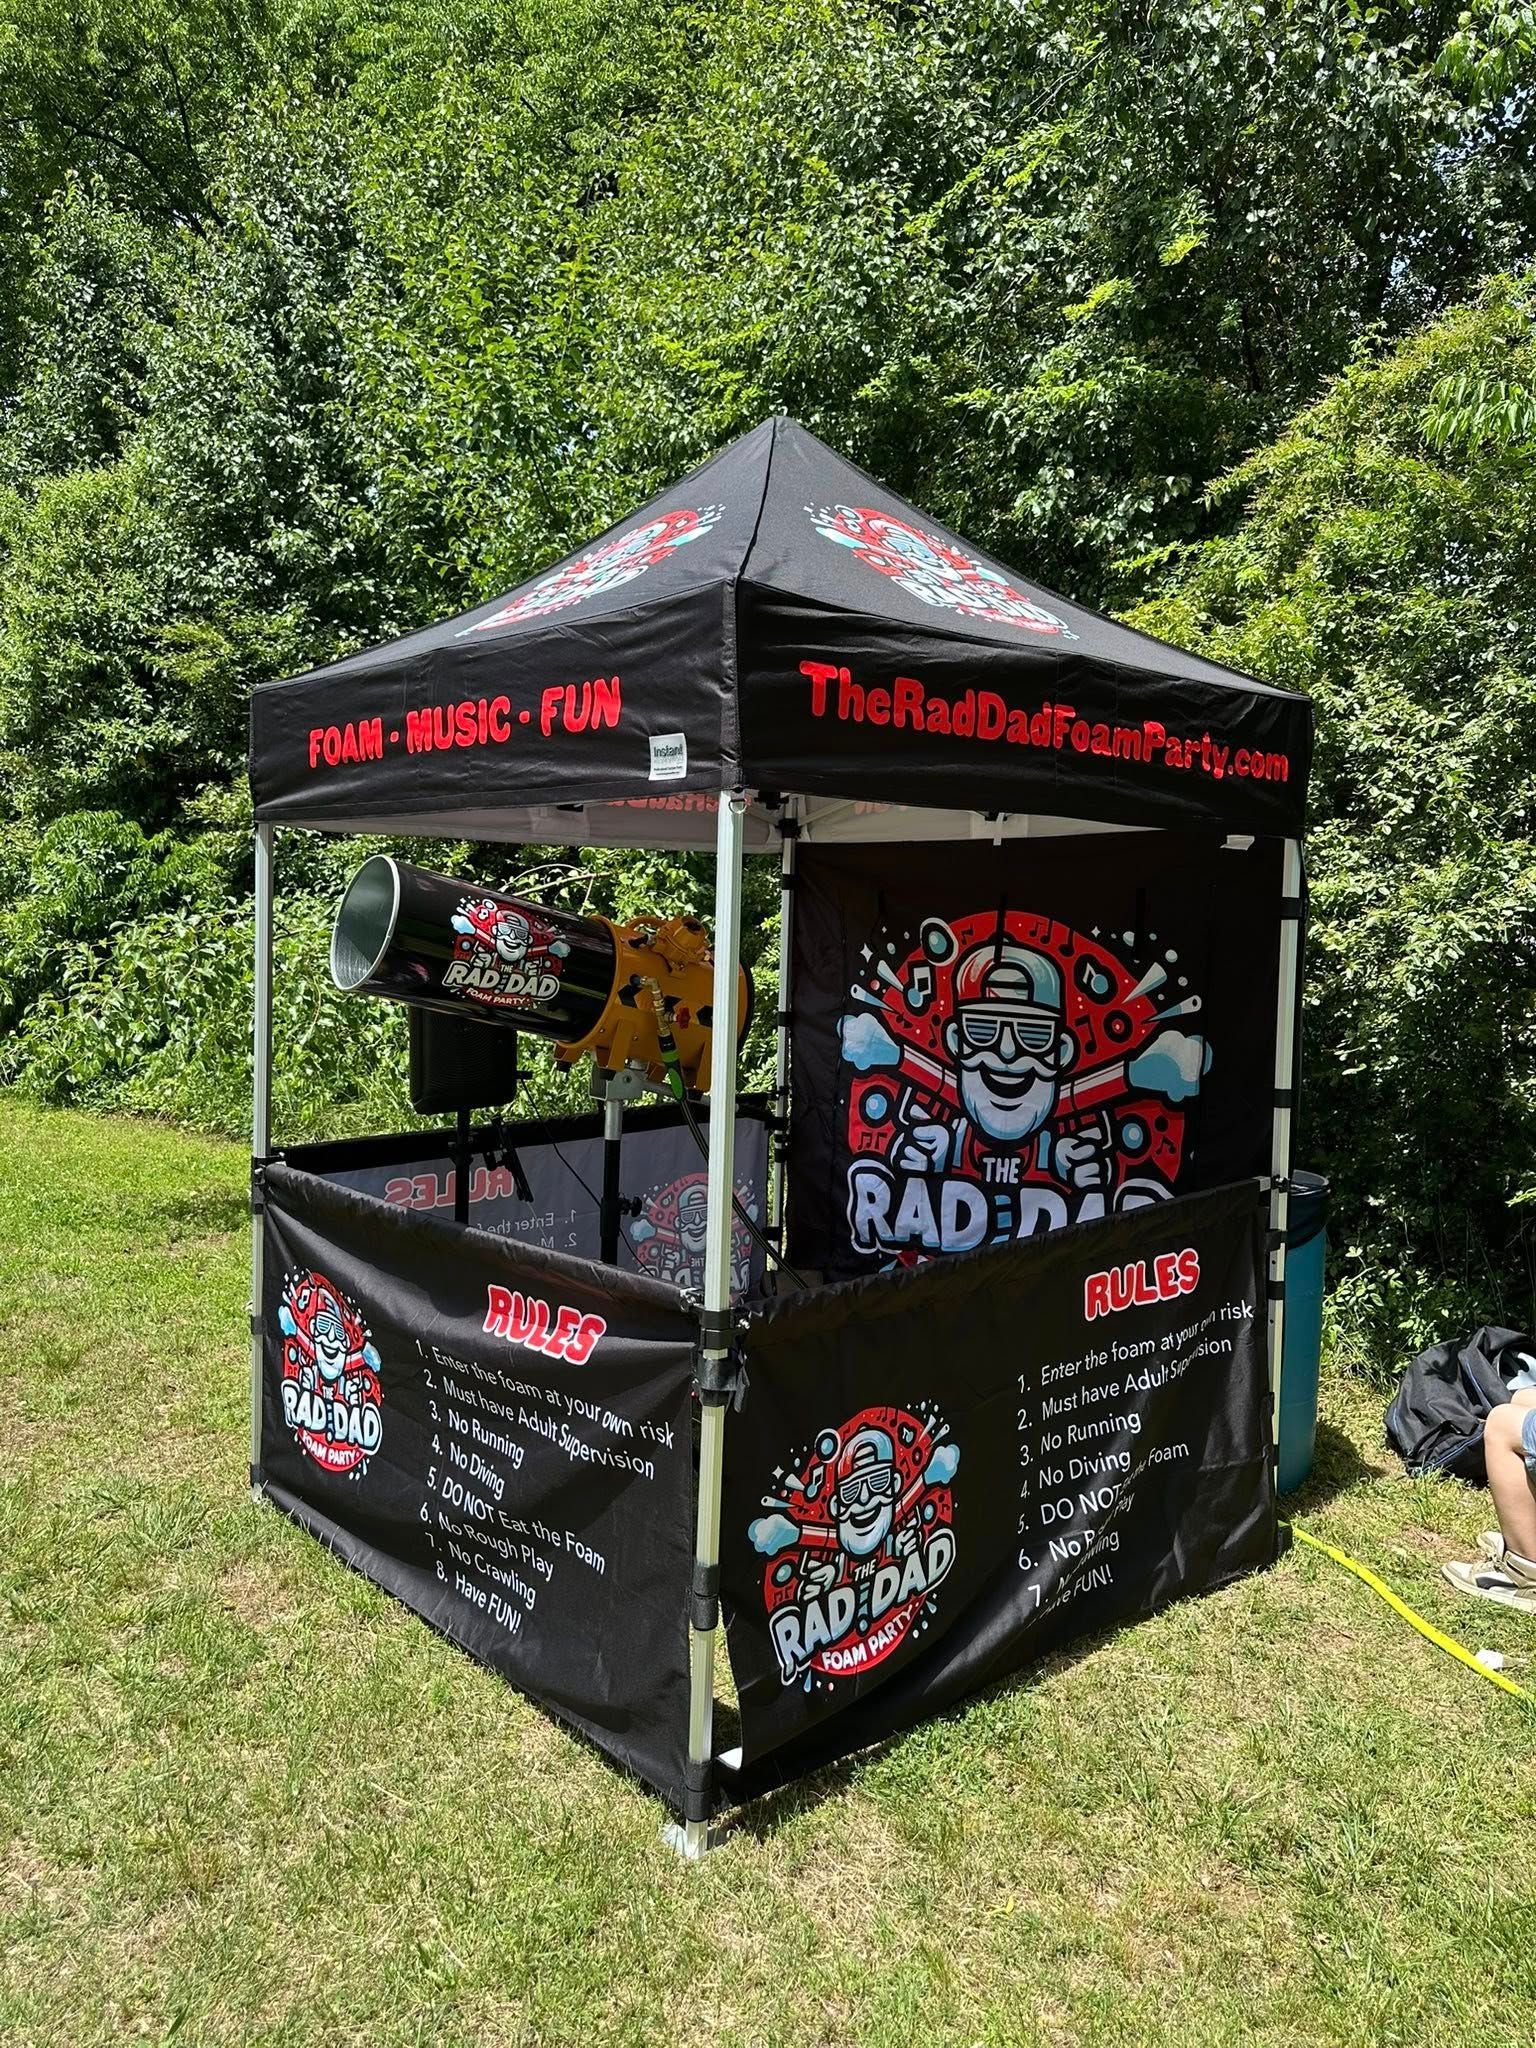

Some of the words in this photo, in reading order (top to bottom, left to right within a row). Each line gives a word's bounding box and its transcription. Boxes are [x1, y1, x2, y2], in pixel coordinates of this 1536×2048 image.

[309, 717, 384, 769] FOAM
[406, 695, 511, 754] MUSIC
[540, 675, 623, 737] FUN
[800, 660, 1289, 783] TheRadDadFoamParty.com
[445, 964, 501, 989] RAD
[503, 973, 557, 998] DAD
[465, 987, 493, 1002] FOAM
[493, 996, 527, 1006] PARTY
[501, 964, 514, 974] THE
[982, 1156, 1021, 1185] THE
[855, 1173, 988, 1253] RAD
[1085, 1248, 1200, 1322] RULES
[482, 1284, 607, 1366] RULES
[1017, 1374, 1031, 1394] 1.
[1041, 1359, 1082, 1387] Enter
[1084, 1350, 1108, 1371] the
[1110, 1339, 1155, 1362] foam
[1160, 1332, 1174, 1350] at
[1175, 1323, 1199, 1351] your
[1220, 1300, 1254, 1320] risk
[283, 1386, 327, 1431] RAD
[333, 1401, 380, 1447] DAD
[415, 1338, 429, 1359] 1.
[431, 1346, 470, 1375] Enter
[472, 1362, 497, 1385] the
[497, 1370, 543, 1400] foam
[545, 1387, 562, 1407] at
[564, 1394, 602, 1422] your
[601, 1411, 634, 1438] own
[640, 1421, 675, 1449] risk
[1017, 1409, 1033, 1431] 2.
[1041, 1393, 1078, 1420] Must
[1081, 1380, 1120, 1406] have
[1124, 1364, 1169, 1394] Adult
[1170, 1337, 1232, 1379] Spsion
[302, 1430, 328, 1460] FOAM
[328, 1449, 356, 1465] PARTY
[423, 1368, 437, 1389] 2.
[443, 1376, 478, 1407] Must
[480, 1393, 514, 1421] have
[518, 1407, 558, 1442] Adult
[558, 1424, 655, 1480] Supervision
[429, 1400, 442, 1422] 3.
[447, 1408, 469, 1435] No
[472, 1419, 525, 1470] Running
[1020, 1444, 1034, 1466] 3.
[1040, 1431, 1062, 1455] No
[1067, 1412, 1142, 1444] Running
[431, 1434, 443, 1456] 4.
[449, 1441, 468, 1469] No
[469, 1453, 505, 1501] Diving
[1017, 1513, 1029, 1534] 5.
[1040, 1498, 1074, 1525] DO
[1078, 1483, 1122, 1515] NOT
[1148, 1443, 1190, 1467] Foam
[1020, 1480, 1031, 1499] 4.
[1039, 1467, 1064, 1489] No
[1069, 1451, 1131, 1481] Diving
[420, 1502, 432, 1524] 6.
[438, 1511, 463, 1537] No
[464, 1524, 519, 1560] Rough
[521, 1544, 554, 1583] Play
[426, 1465, 438, 1491] 5.
[442, 1477, 463, 1506] DO
[463, 1498, 495, 1524] NOT
[498, 1510, 530, 1535] Eat
[532, 1521, 562, 1547] the
[565, 1531, 606, 1576] Foam
[1018, 1548, 1039, 1570] 6.
[1048, 1537, 1081, 1562] No
[425, 1532, 443, 1551] 7.
[448, 1541, 471, 1566] No
[475, 1556, 537, 1611] Crawling
[436, 1560, 448, 1583] 8.
[455, 1571, 486, 1609] Have
[487, 1592, 522, 1635] FUN!
[774, 1586, 855, 1670] RAD
[872, 1537, 952, 1618] DAD
[854, 1558, 877, 1582] THE
[1027, 1584, 1049, 1607] 7.
[1074, 1563, 1114, 1597] FUN!
[822, 1647, 867, 1671] FOAM
[868, 1604, 913, 1651] PARTY
